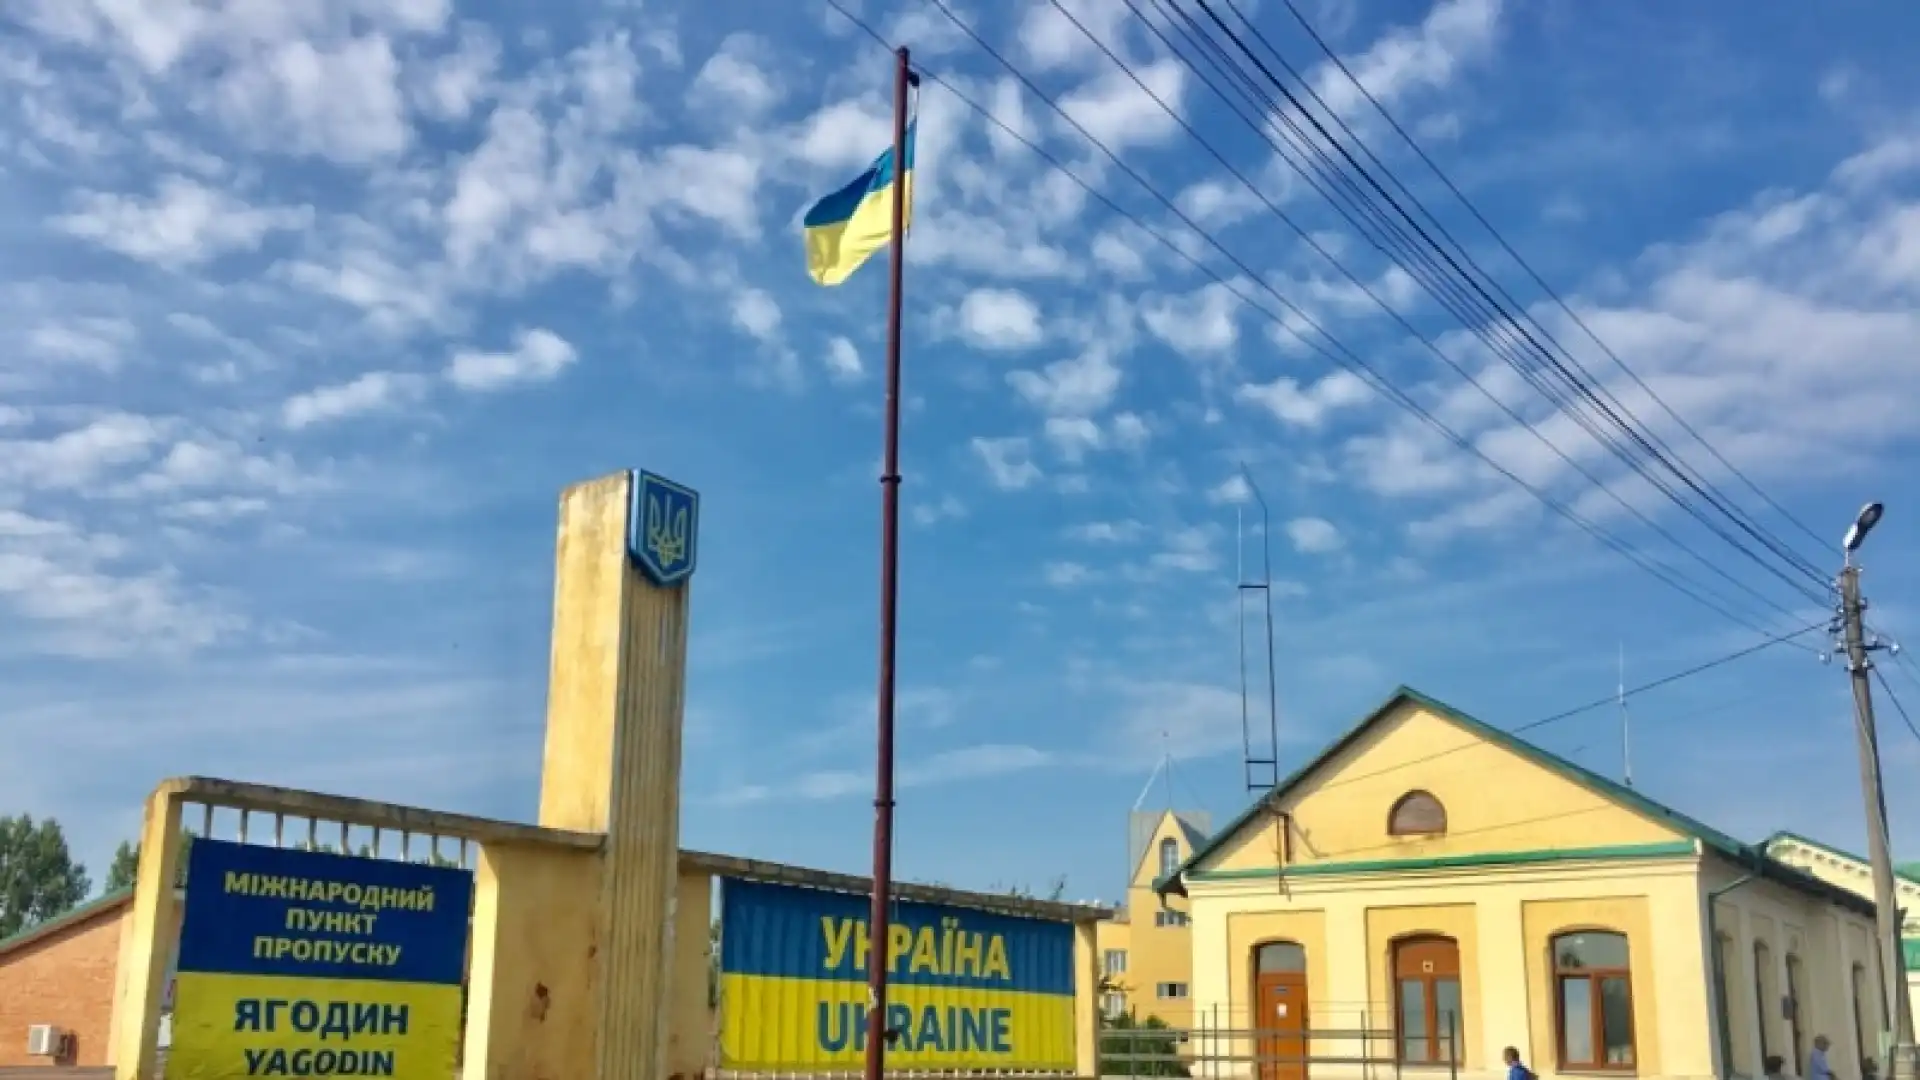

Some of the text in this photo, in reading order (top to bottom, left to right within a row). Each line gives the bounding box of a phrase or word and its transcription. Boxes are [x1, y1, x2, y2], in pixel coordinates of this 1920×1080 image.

[224, 870, 435, 911] МІЖНАРОДНИЙ
[285, 908, 377, 935] ПУНКТ
[253, 935, 402, 966] ПРОПУСКУ
[234, 998, 409, 1040] ЯГОДИН
[243, 1049, 394, 1076] YAGODIN
